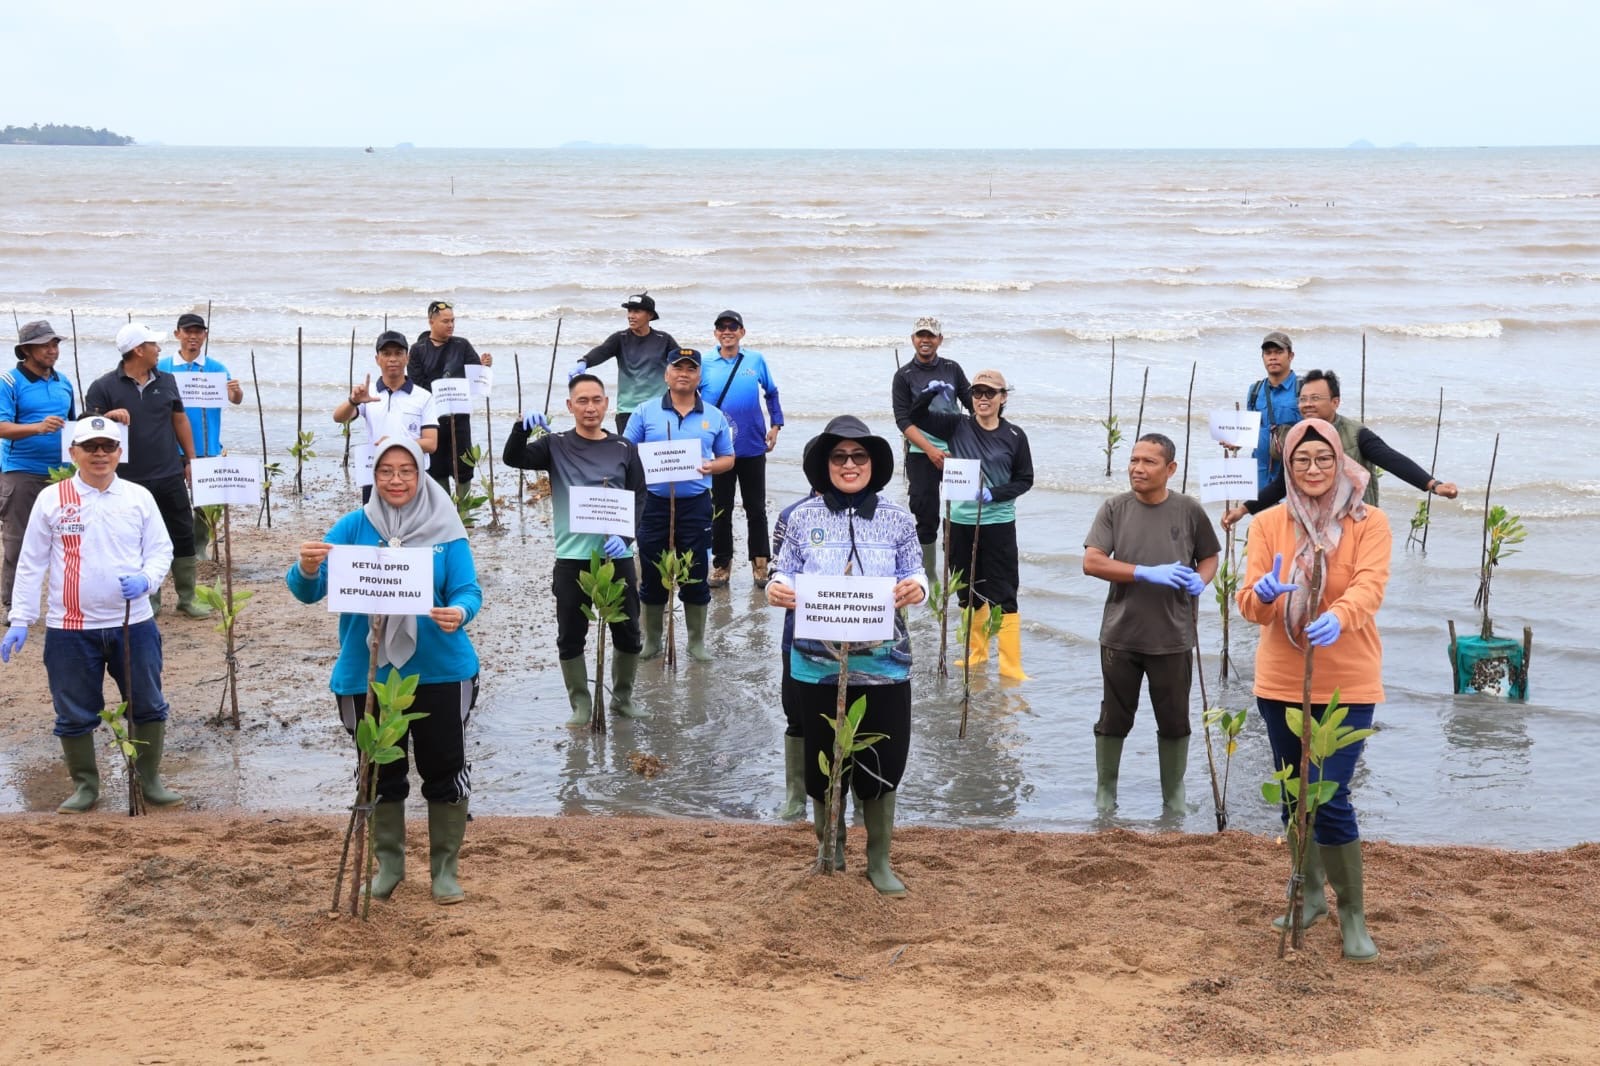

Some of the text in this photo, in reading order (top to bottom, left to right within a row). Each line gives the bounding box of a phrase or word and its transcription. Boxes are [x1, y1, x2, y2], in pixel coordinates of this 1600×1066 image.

[647, 464, 695, 473] TANJUNGPINANG
[351, 561, 410, 571] KETUA DPRD
[359, 575, 402, 585] PROVINSI
[339, 588, 422, 598] KEPULAUAN RIAU
[817, 590, 874, 599] SEKRETARIS
[804, 602, 886, 612] DAERAH PROVINSI
[806, 614, 884, 624] KEPULAUAN RIAU
